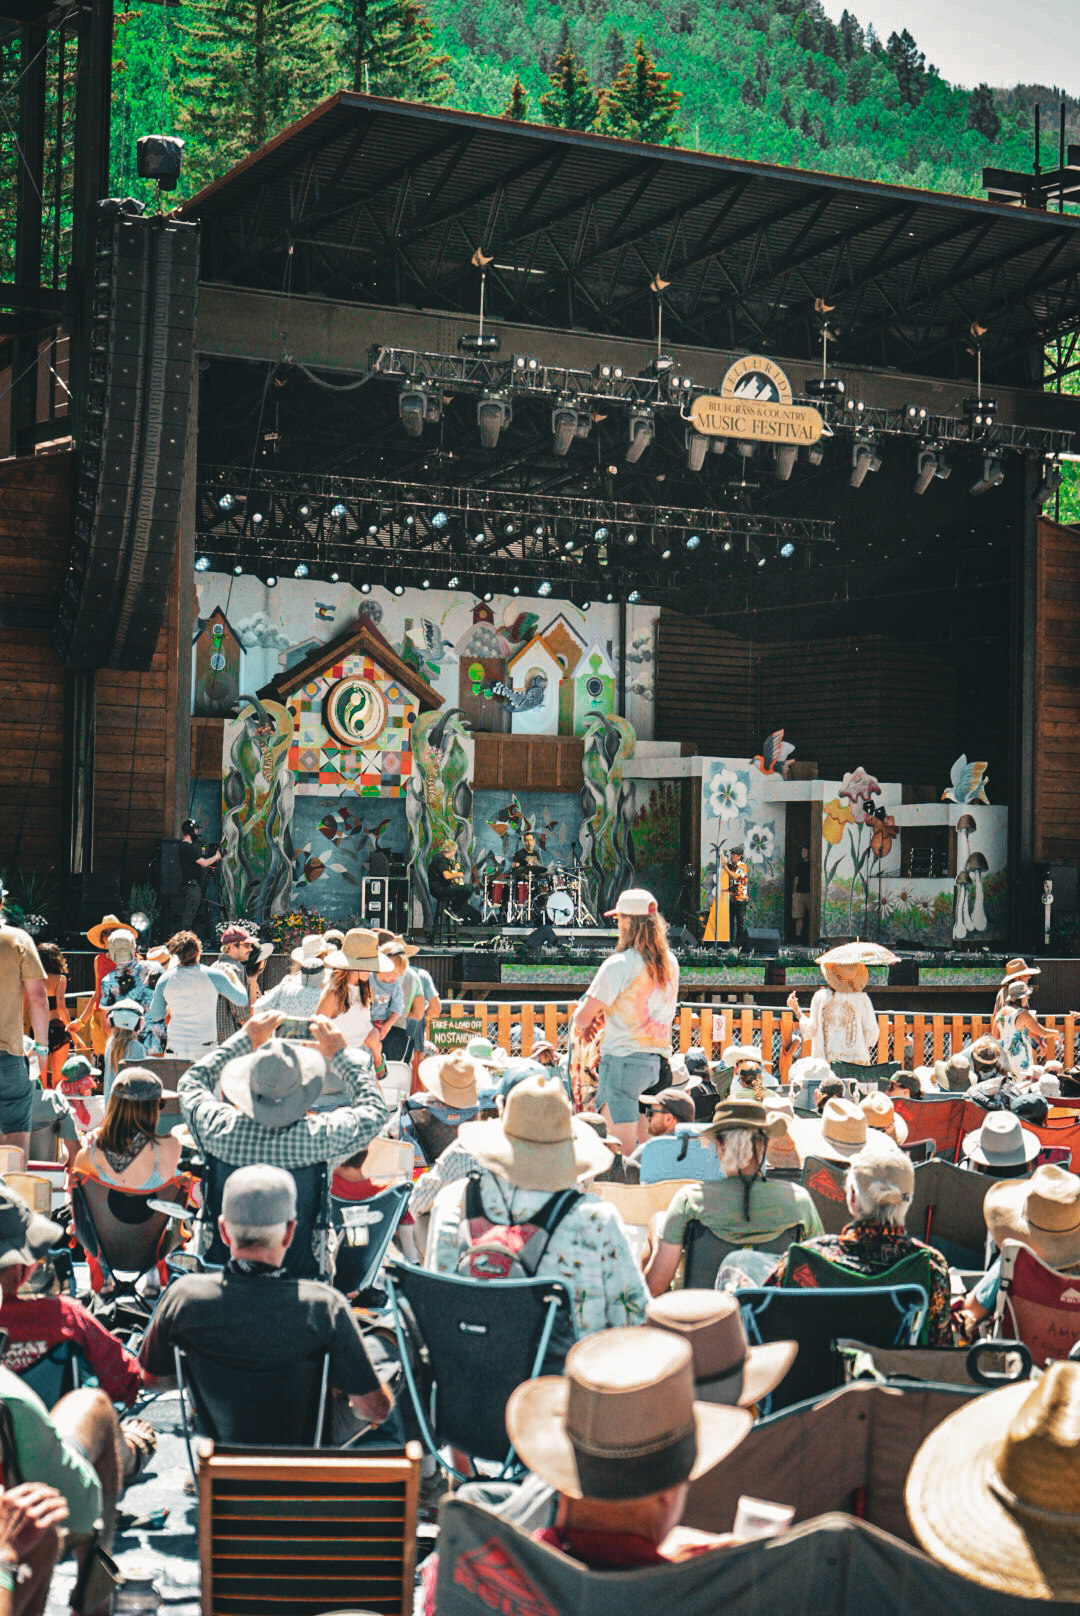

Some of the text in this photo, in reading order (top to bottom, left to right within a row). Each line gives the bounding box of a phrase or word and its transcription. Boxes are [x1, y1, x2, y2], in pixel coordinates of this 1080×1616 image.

[723, 359, 792, 402] TELLURIDE
[708, 401, 755, 415] BLUEGRASS
[757, 409, 763, 417] &
[763, 409, 807, 421] COUNTRY
[698, 413, 817, 440] MUSIC FESTIVAL
[432, 1020, 482, 1029] TAKE A LOAD OFF
[434, 1032, 446, 1044] NO
